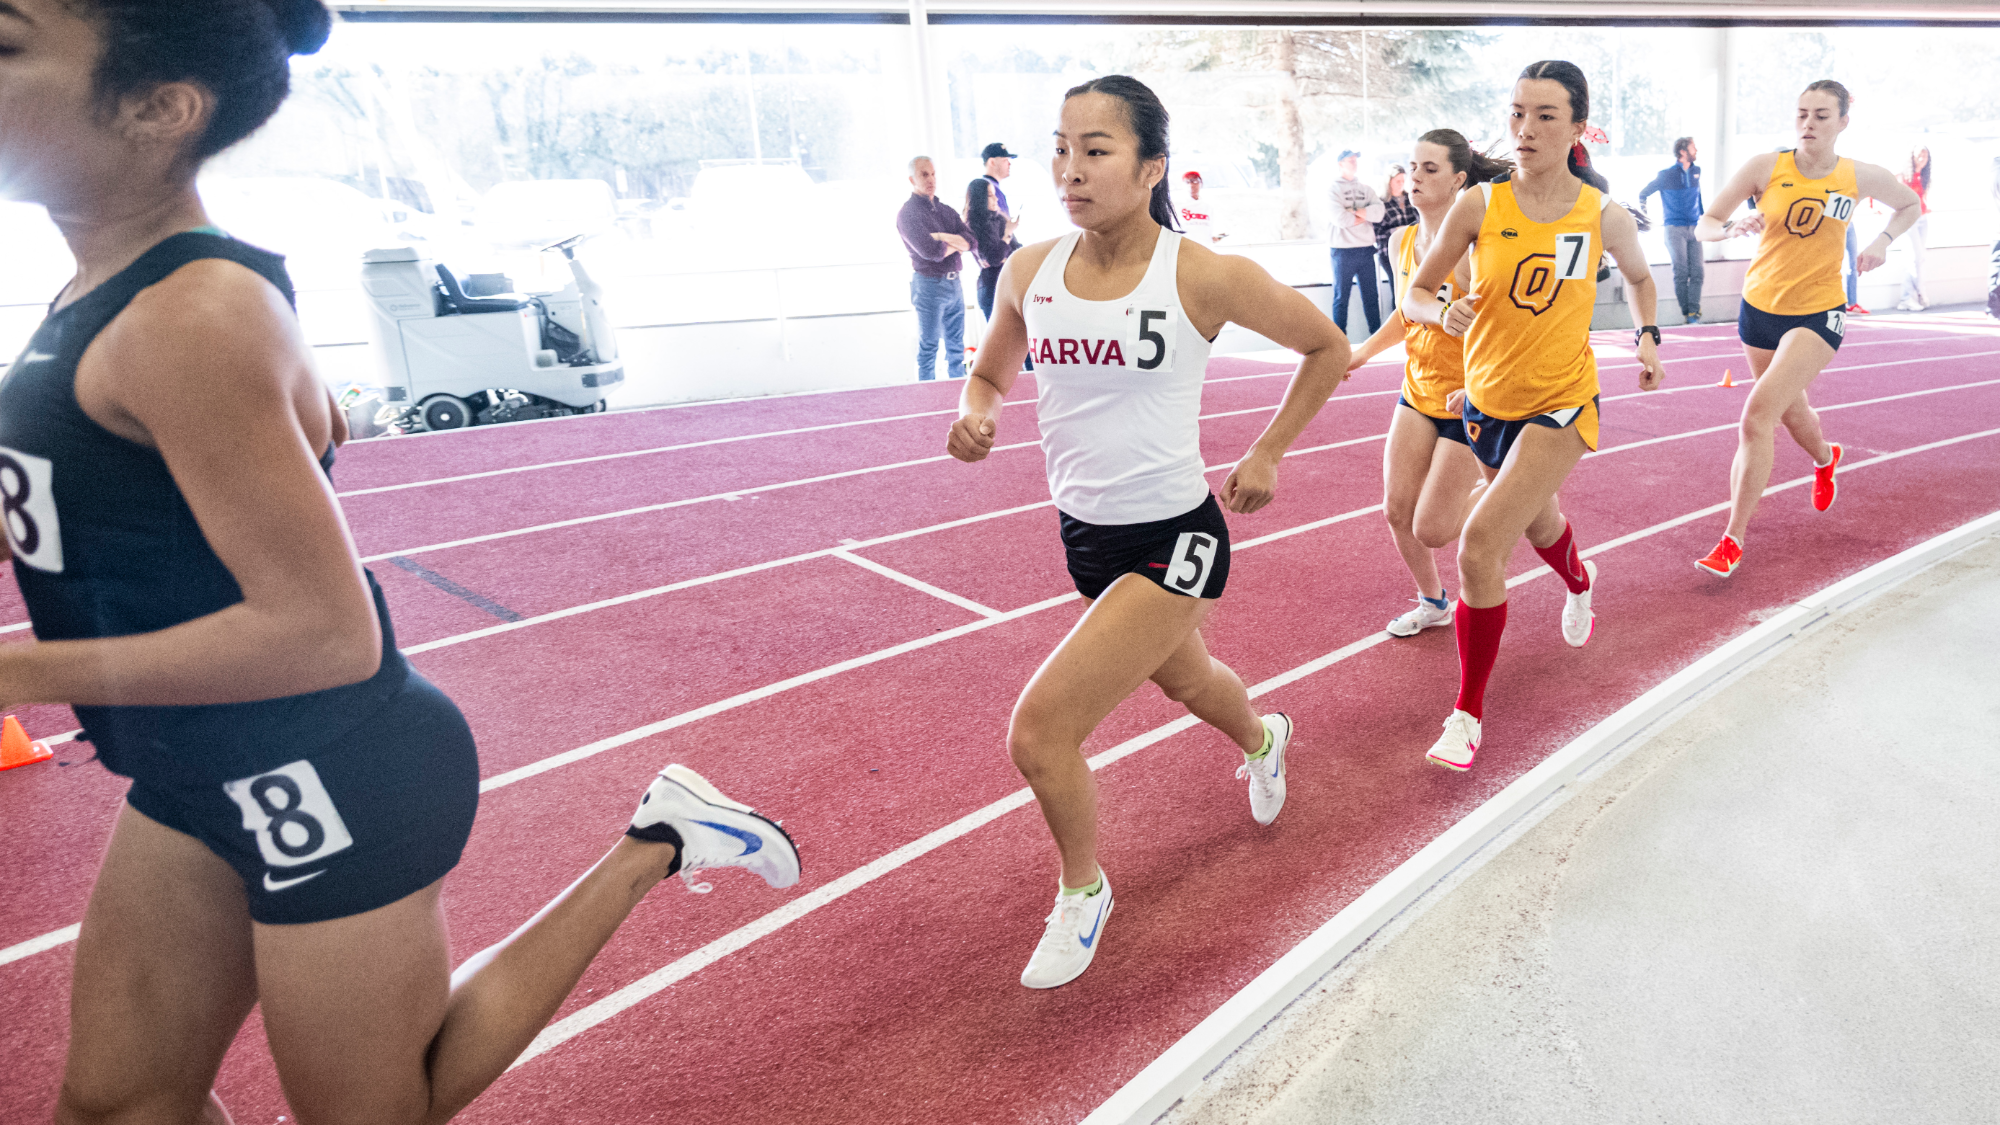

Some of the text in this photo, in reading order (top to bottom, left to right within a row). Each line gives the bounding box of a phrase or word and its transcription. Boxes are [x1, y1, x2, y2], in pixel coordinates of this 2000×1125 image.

[1785, 197, 1826, 238] Q
[1833, 197, 1851, 220] 10
[1564, 235, 1584, 277] 7
[1033, 294, 1046, 305] Ivy
[1508, 253, 1565, 316] Q
[1029, 338, 1126, 366] HARVA
[1137, 310, 1167, 370] 5
[0, 453, 39, 555] 8
[1175, 534, 1211, 590] 5
[250, 774, 325, 858] 8
